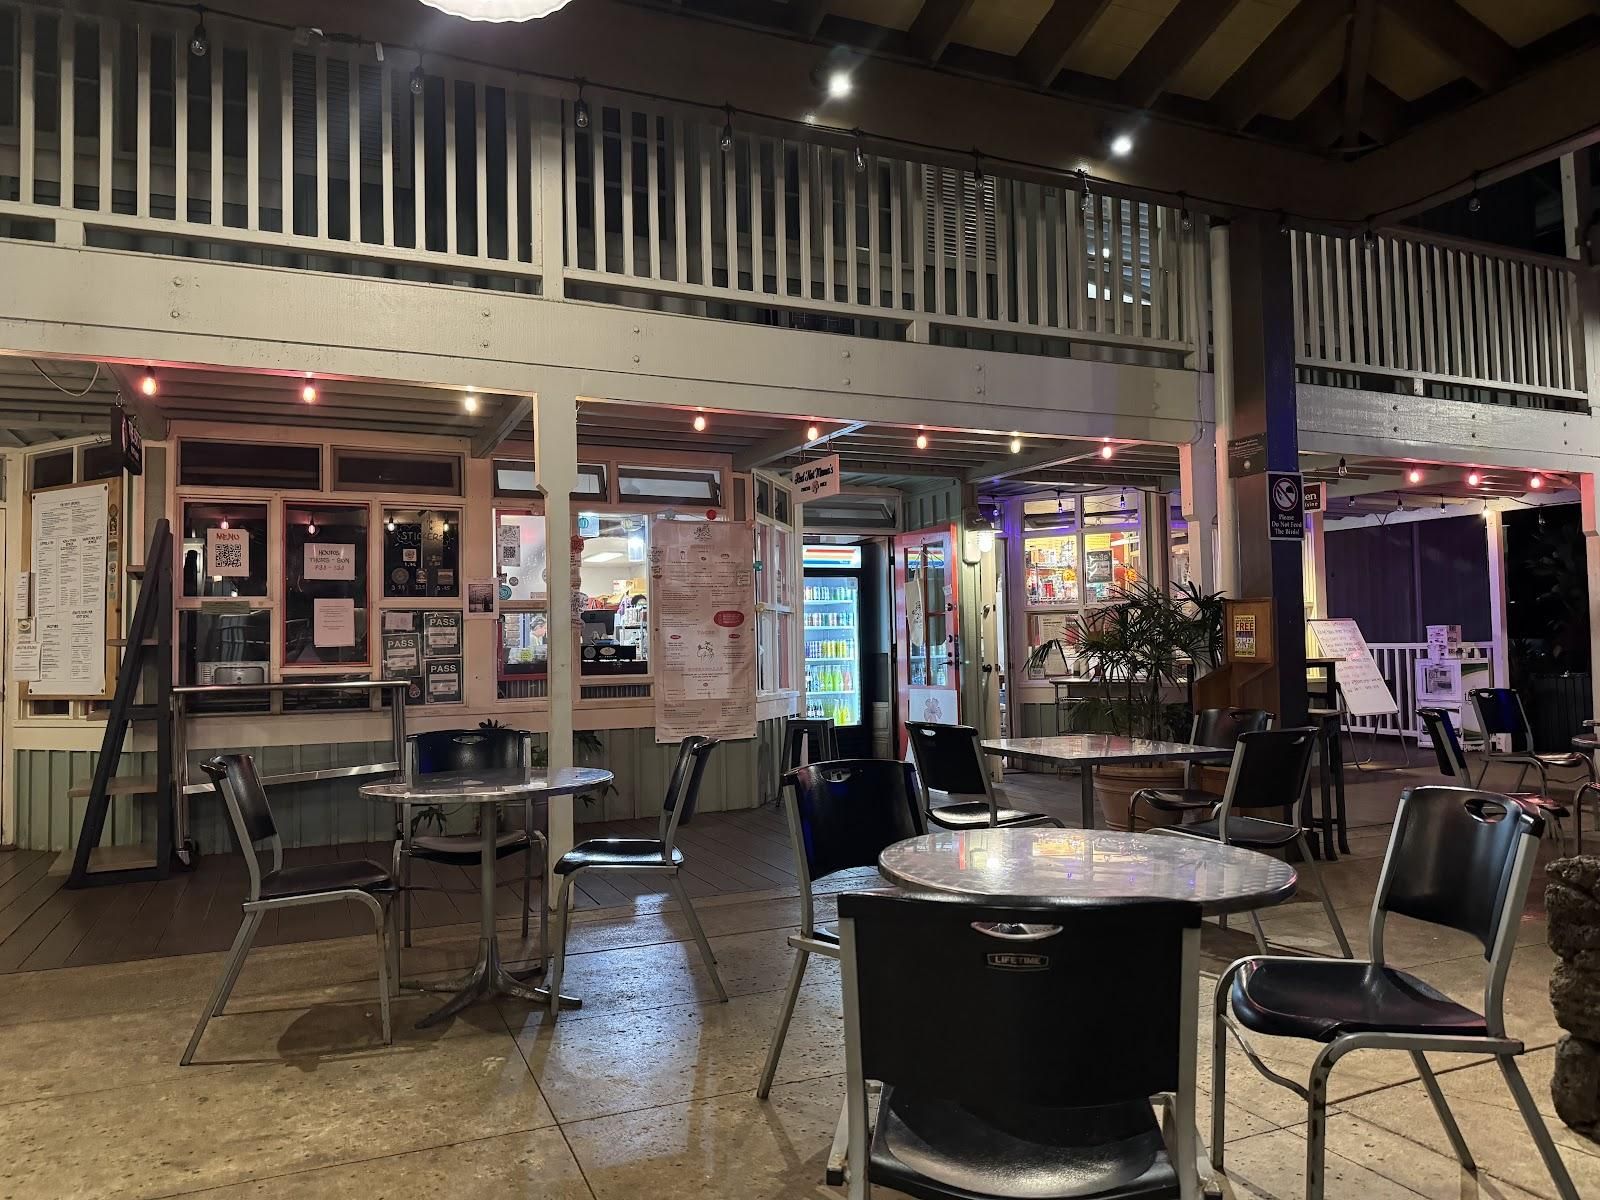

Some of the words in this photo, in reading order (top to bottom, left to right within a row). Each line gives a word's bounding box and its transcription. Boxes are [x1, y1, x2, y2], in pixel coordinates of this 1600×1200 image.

[1303, 493, 1317, 501] en
[1271, 520, 1280, 528] Do
[216, 532, 240, 540] MENU
[429, 618, 456, 626] PASS
[1235, 622, 1254, 631] FREE
[387, 639, 414, 648] PASS
[430, 664, 457, 673] PASS
[995, 955, 1041, 964] LIFETIME
